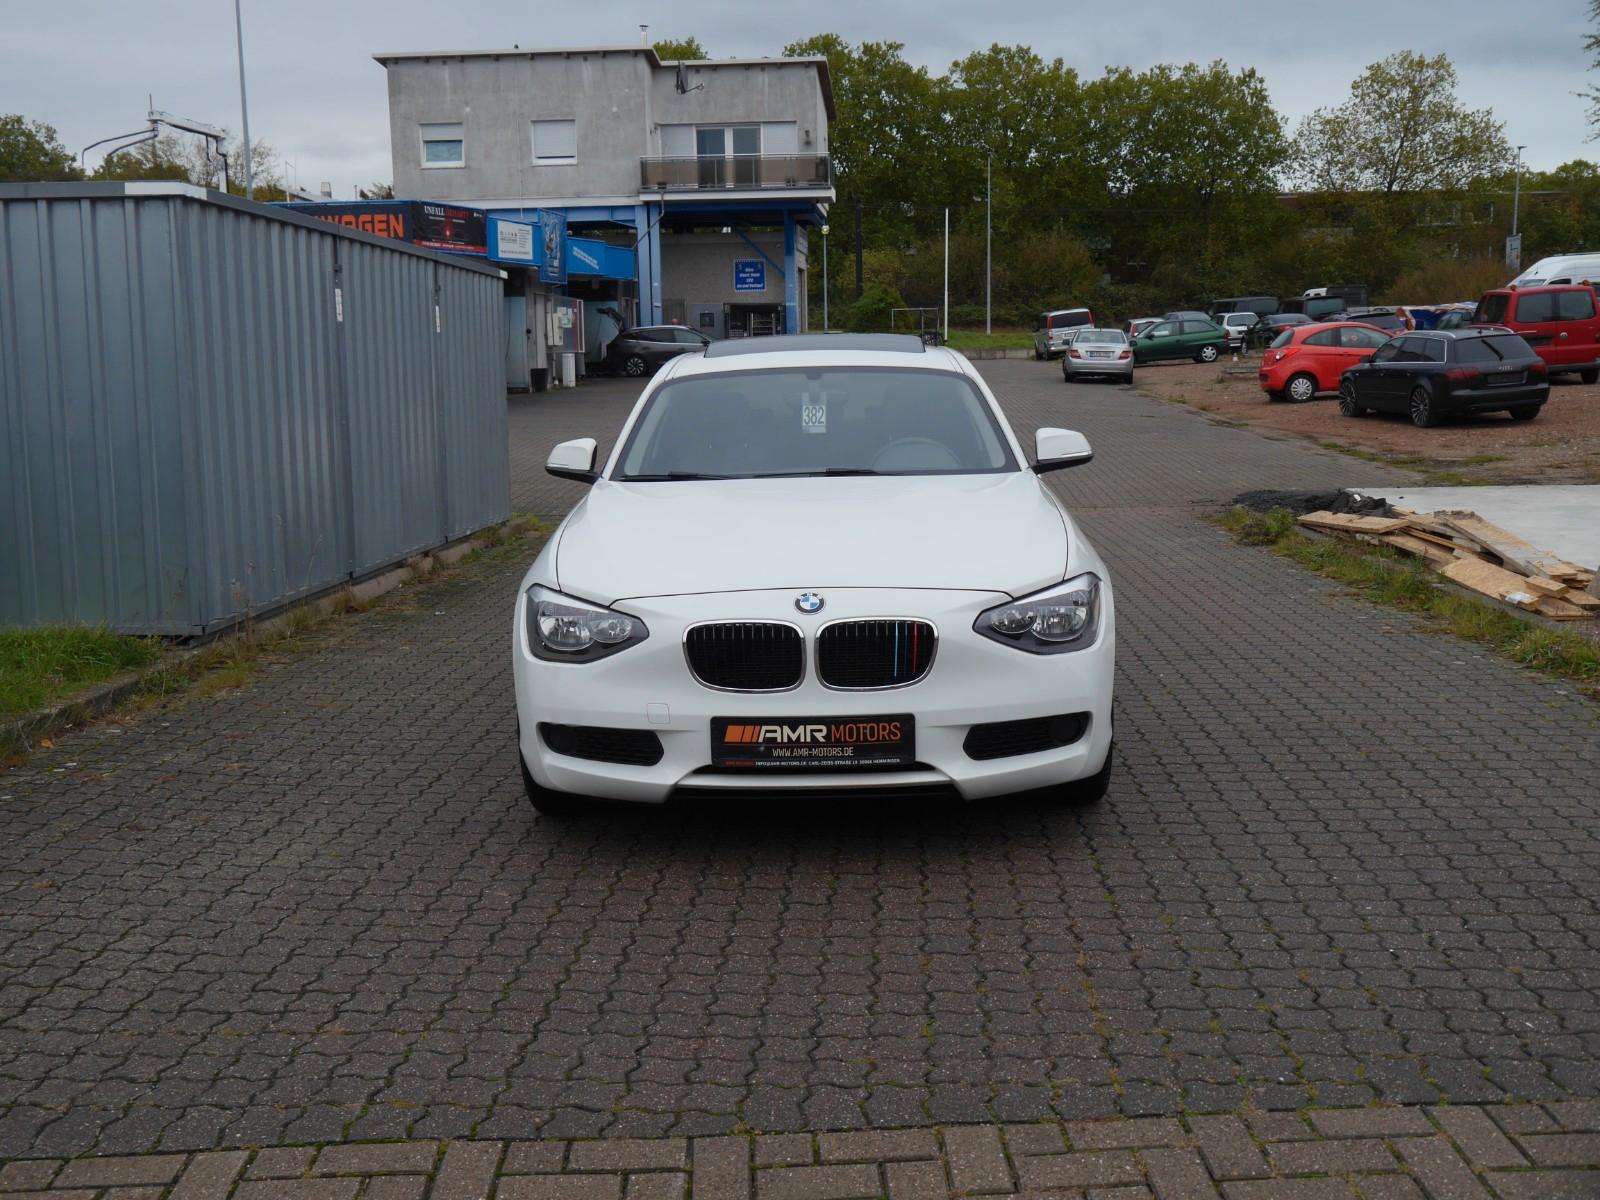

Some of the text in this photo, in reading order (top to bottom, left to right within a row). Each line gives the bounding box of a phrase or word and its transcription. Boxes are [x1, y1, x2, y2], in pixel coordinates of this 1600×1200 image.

[424, 205, 445, 216] UNFALL
[320, 213, 404, 238] AGEN
[804, 406, 825, 425] 382
[757, 722, 901, 743] AMR MOTORS
[772, 746, 854, 757] WWW.AMR-MOTORS.DE
